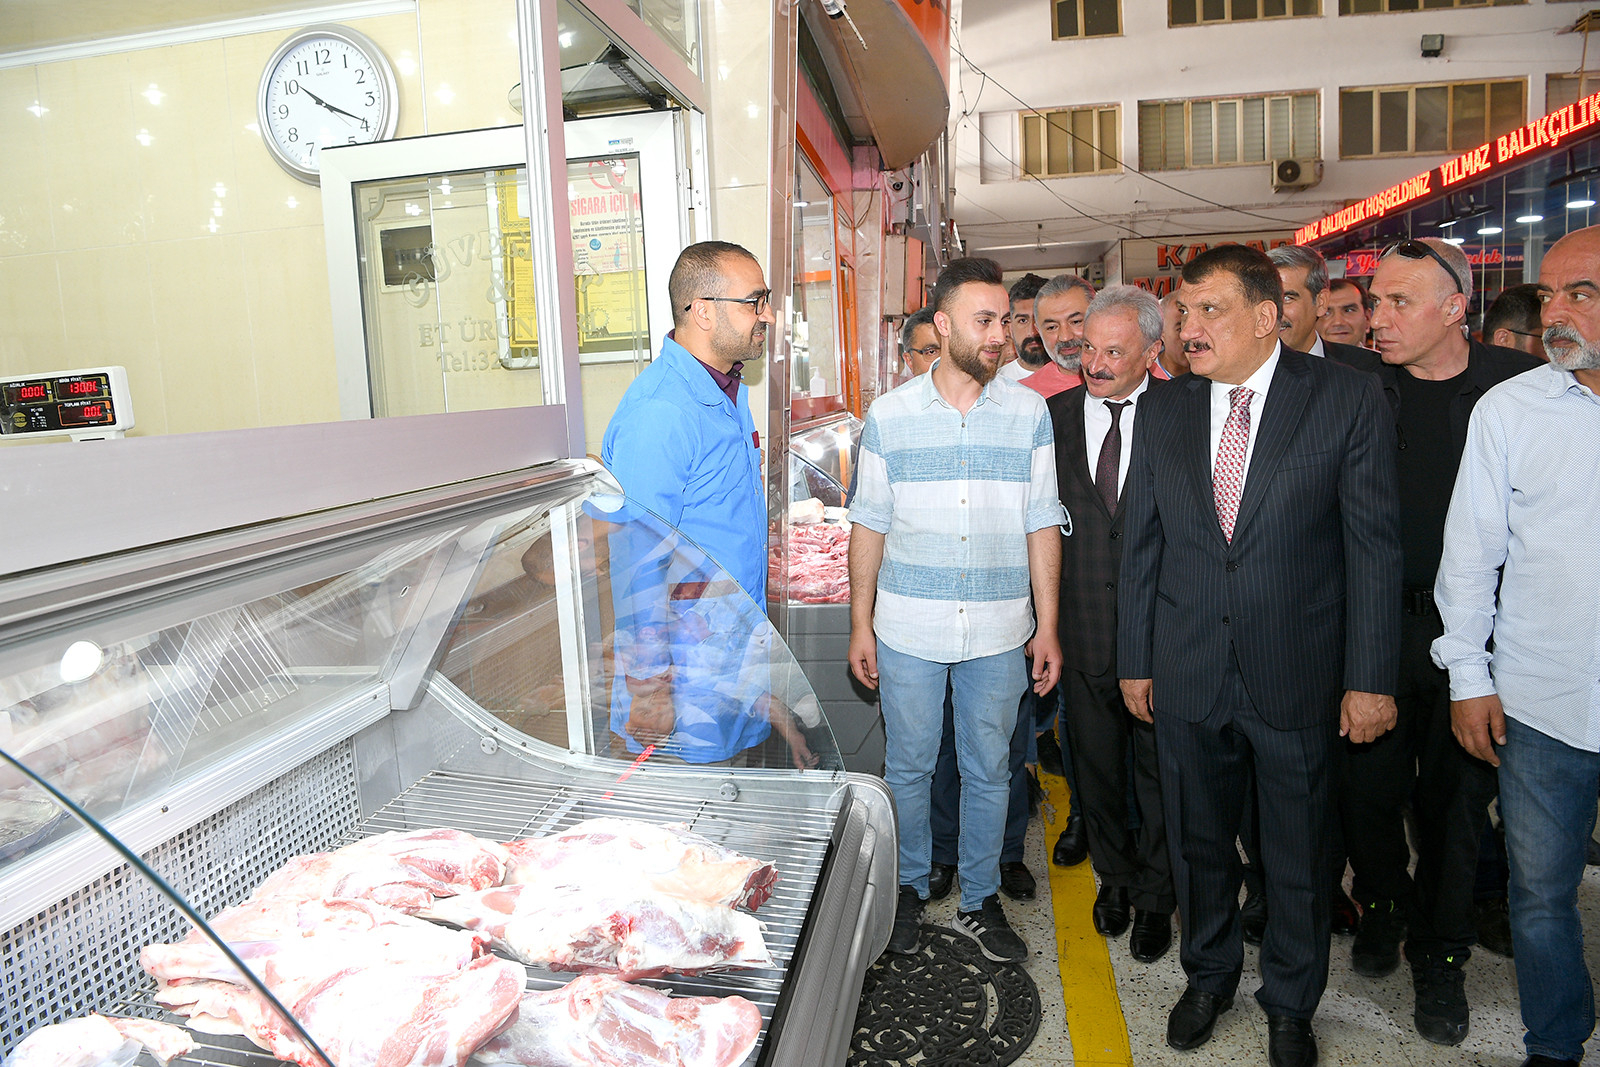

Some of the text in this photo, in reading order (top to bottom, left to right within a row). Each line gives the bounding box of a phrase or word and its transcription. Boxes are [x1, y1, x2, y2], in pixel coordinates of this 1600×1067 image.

[315, 48, 331, 65] 12
[343, 54, 348, 69] 1
[296, 60, 309, 76] 11
[355, 69, 365, 84] 2
[284, 79, 299, 95] 10
[364, 92, 375, 107] 3
[278, 104, 289, 119] 9
[360, 117, 370, 132] 4
[288, 127, 299, 142] 8
[306, 142, 315, 157] 7
[1294, 91, 1600, 246] YILMAZ BALIKÇILIK HOŞGELDİNİZ YILMAZ BALIKÇILIK
[486, 270, 515, 304] &
[418, 322, 452, 347] ET
